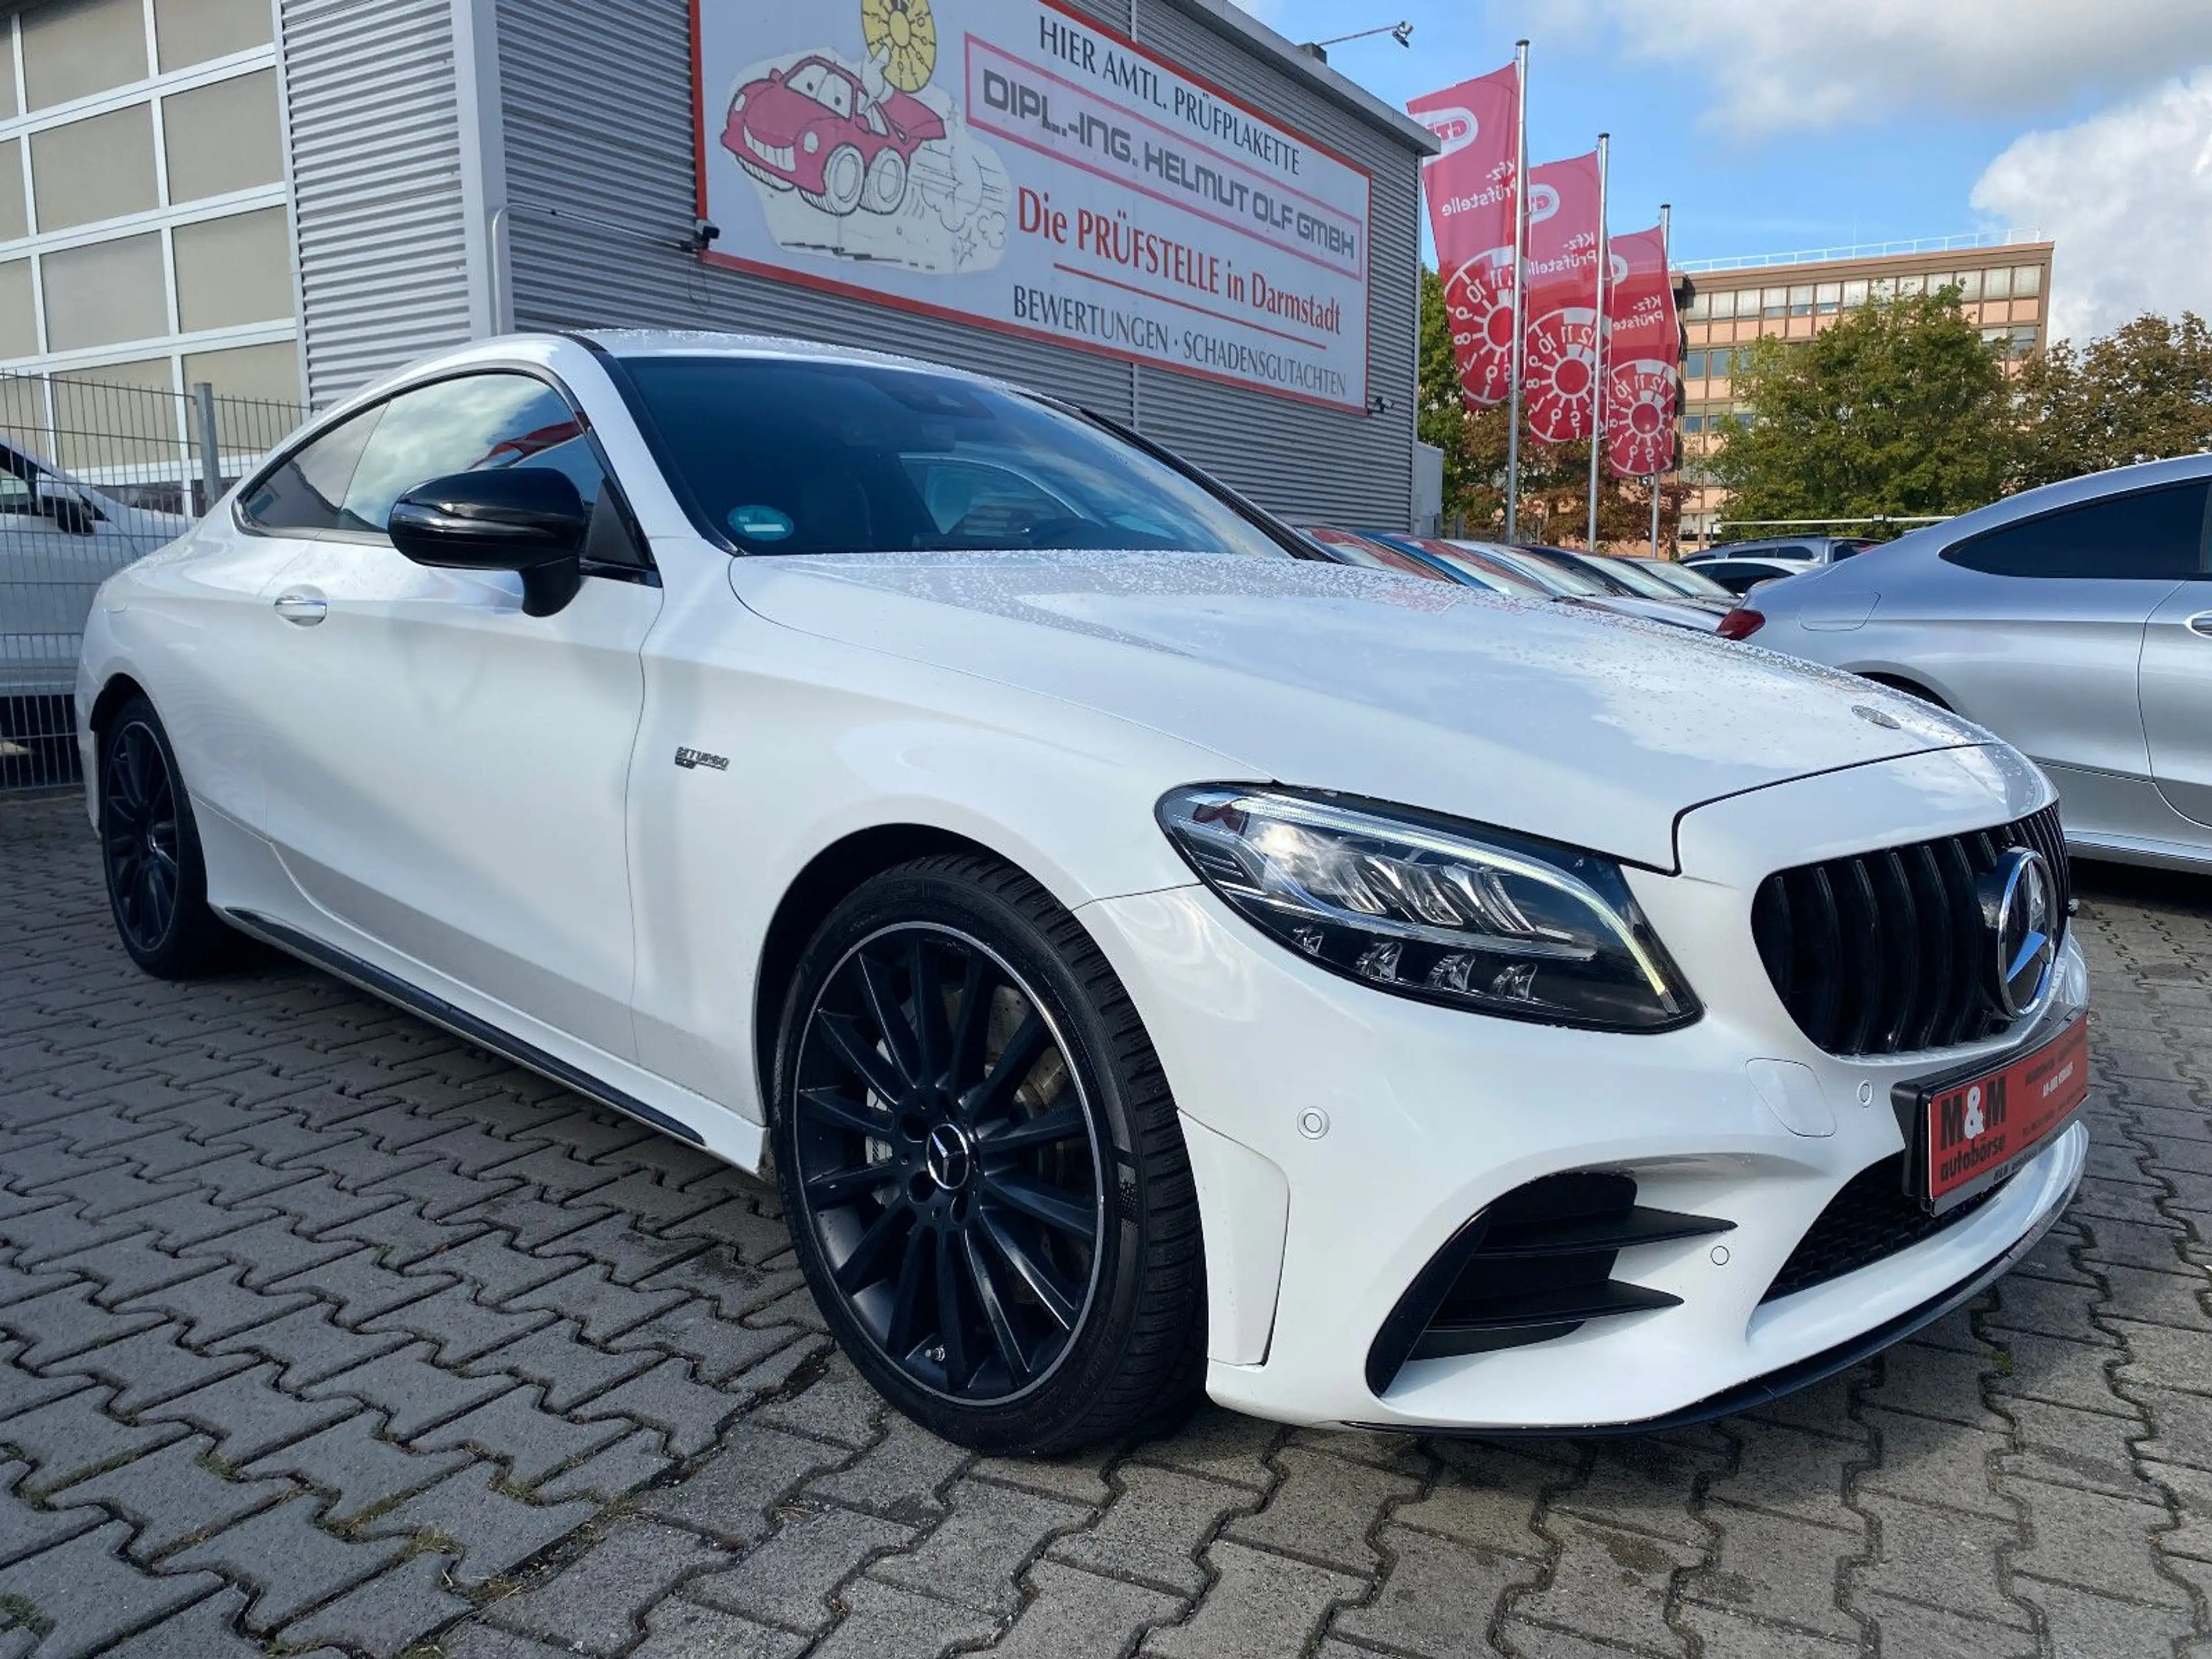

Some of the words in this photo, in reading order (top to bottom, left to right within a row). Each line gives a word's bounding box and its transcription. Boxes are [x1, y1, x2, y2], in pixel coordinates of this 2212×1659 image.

[983, 68, 1138, 167] DIPL.-ING.
[1144, 141, 1249, 213] HELMUT
[1252, 192, 1293, 230] OLF
[1296, 211, 1355, 260] GMBH
[1039, 15, 1096, 74] HIER
[1103, 50, 1167, 110] AMTL.
[1174, 86, 1300, 176] PRÜFPLAKETTE
[1019, 186, 1067, 244] Die
[1078, 207, 1219, 295] PRÜFSTELLE
[1227, 260, 1245, 302] in
[1252, 271, 1341, 336] Darmstadt
[1013, 285, 1168, 354] BEWERTUNGEN
[1184, 329, 1346, 397] SCHADENSGUTACHTEN
[1940, 1075, 2006, 1151] M&M
